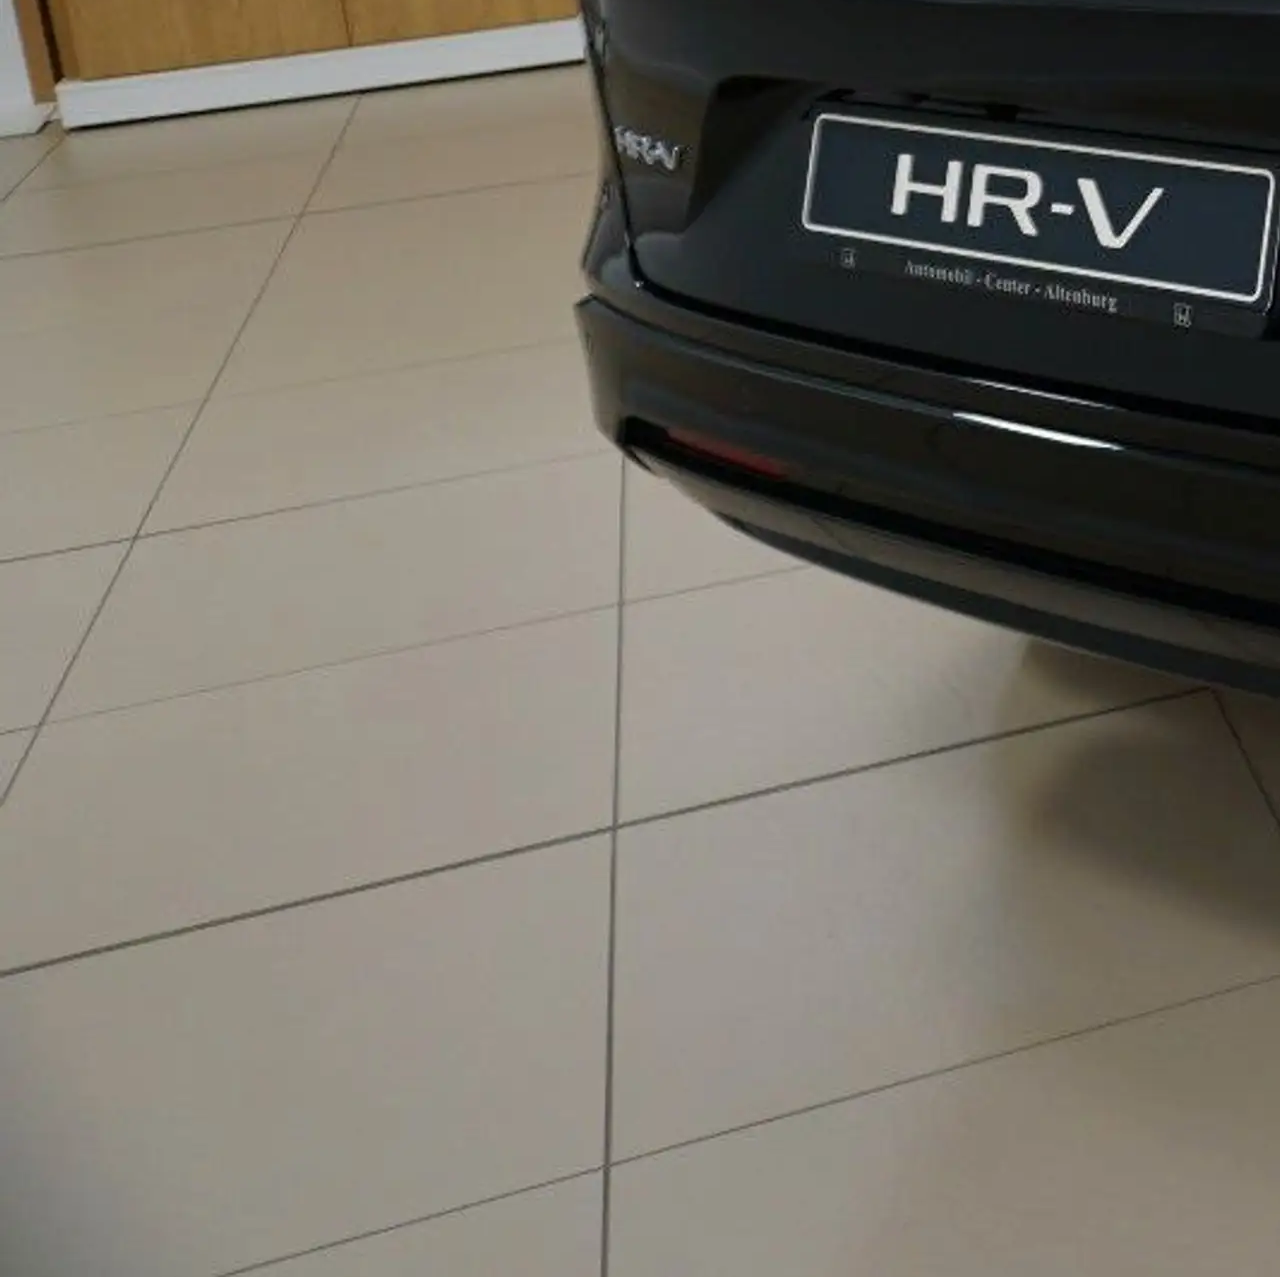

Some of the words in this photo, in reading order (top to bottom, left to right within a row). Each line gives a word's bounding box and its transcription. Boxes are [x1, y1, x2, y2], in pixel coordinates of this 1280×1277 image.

[891, 154, 1164, 248] HR-V
[984, 272, 1030, 295] Center
[1044, 284, 1118, 313] Altenburg
